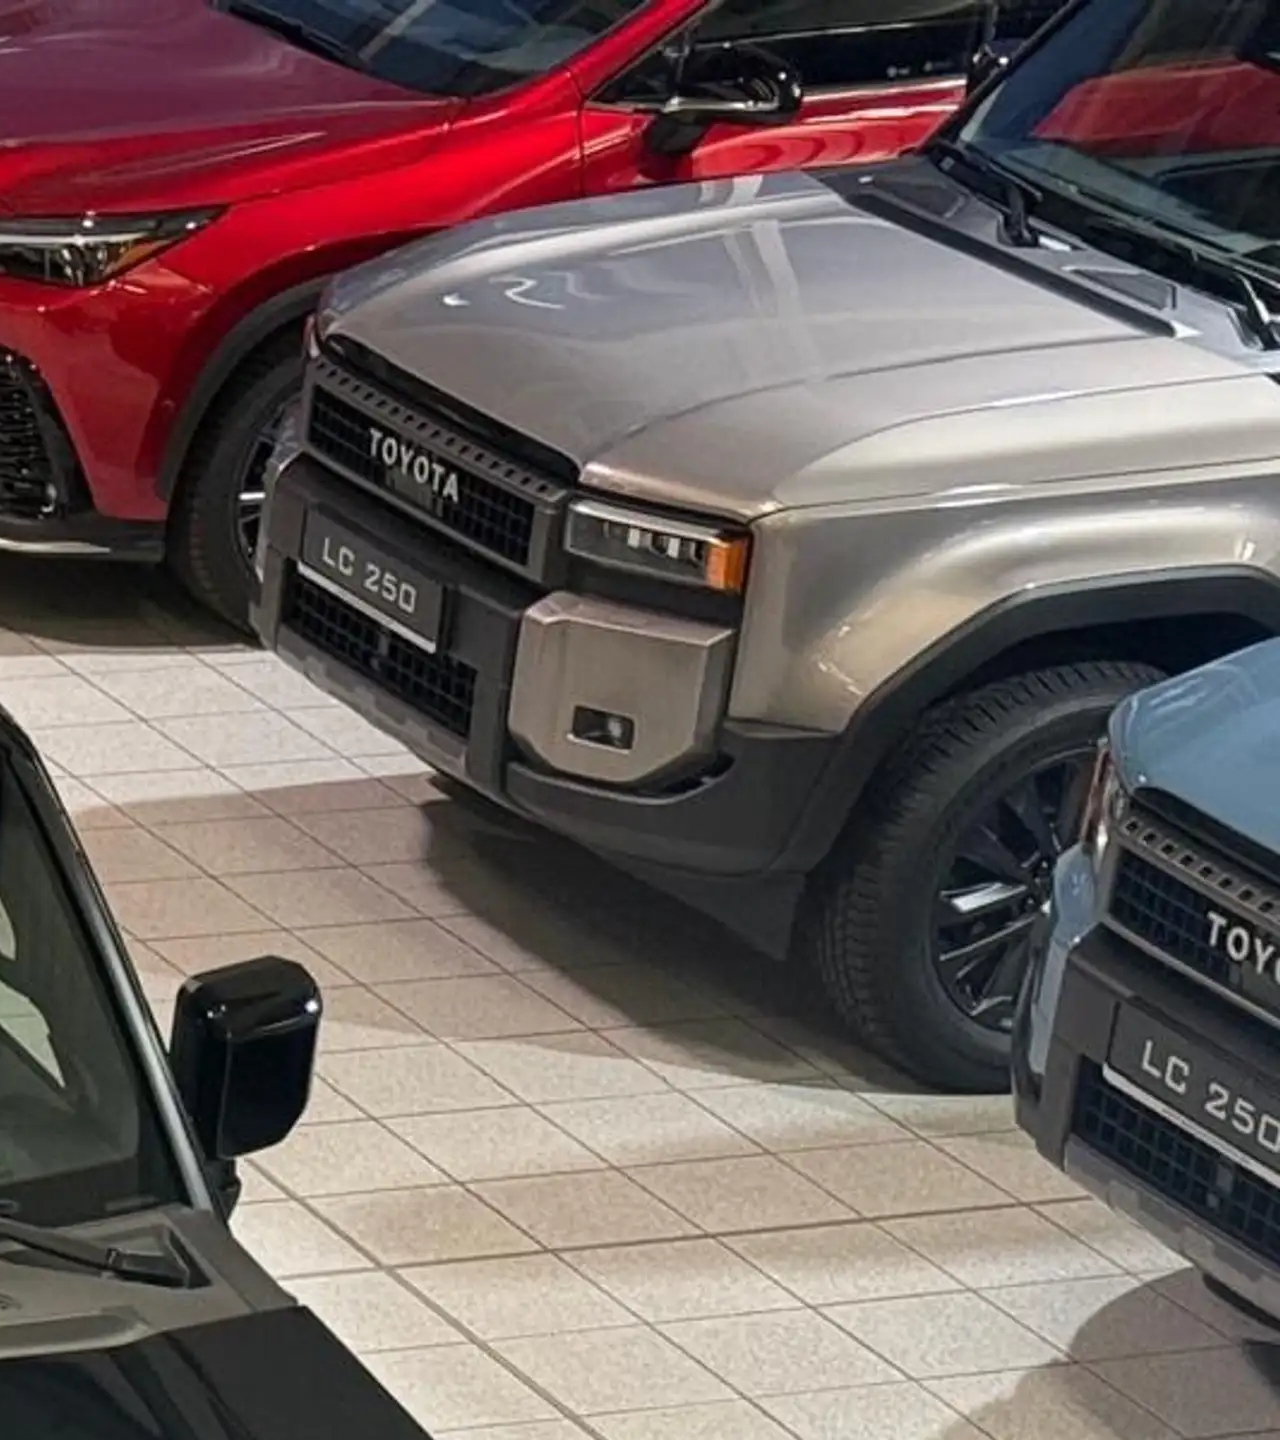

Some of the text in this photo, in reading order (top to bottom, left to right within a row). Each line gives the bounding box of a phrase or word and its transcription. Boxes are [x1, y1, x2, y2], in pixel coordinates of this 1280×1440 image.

[369, 427, 460, 504] TOYOTA
[321, 537, 417, 614] LC 250
[1206, 909, 1280, 986] TOY
[1141, 1039, 1190, 1095] LC
[1203, 1081, 1280, 1154] 250
